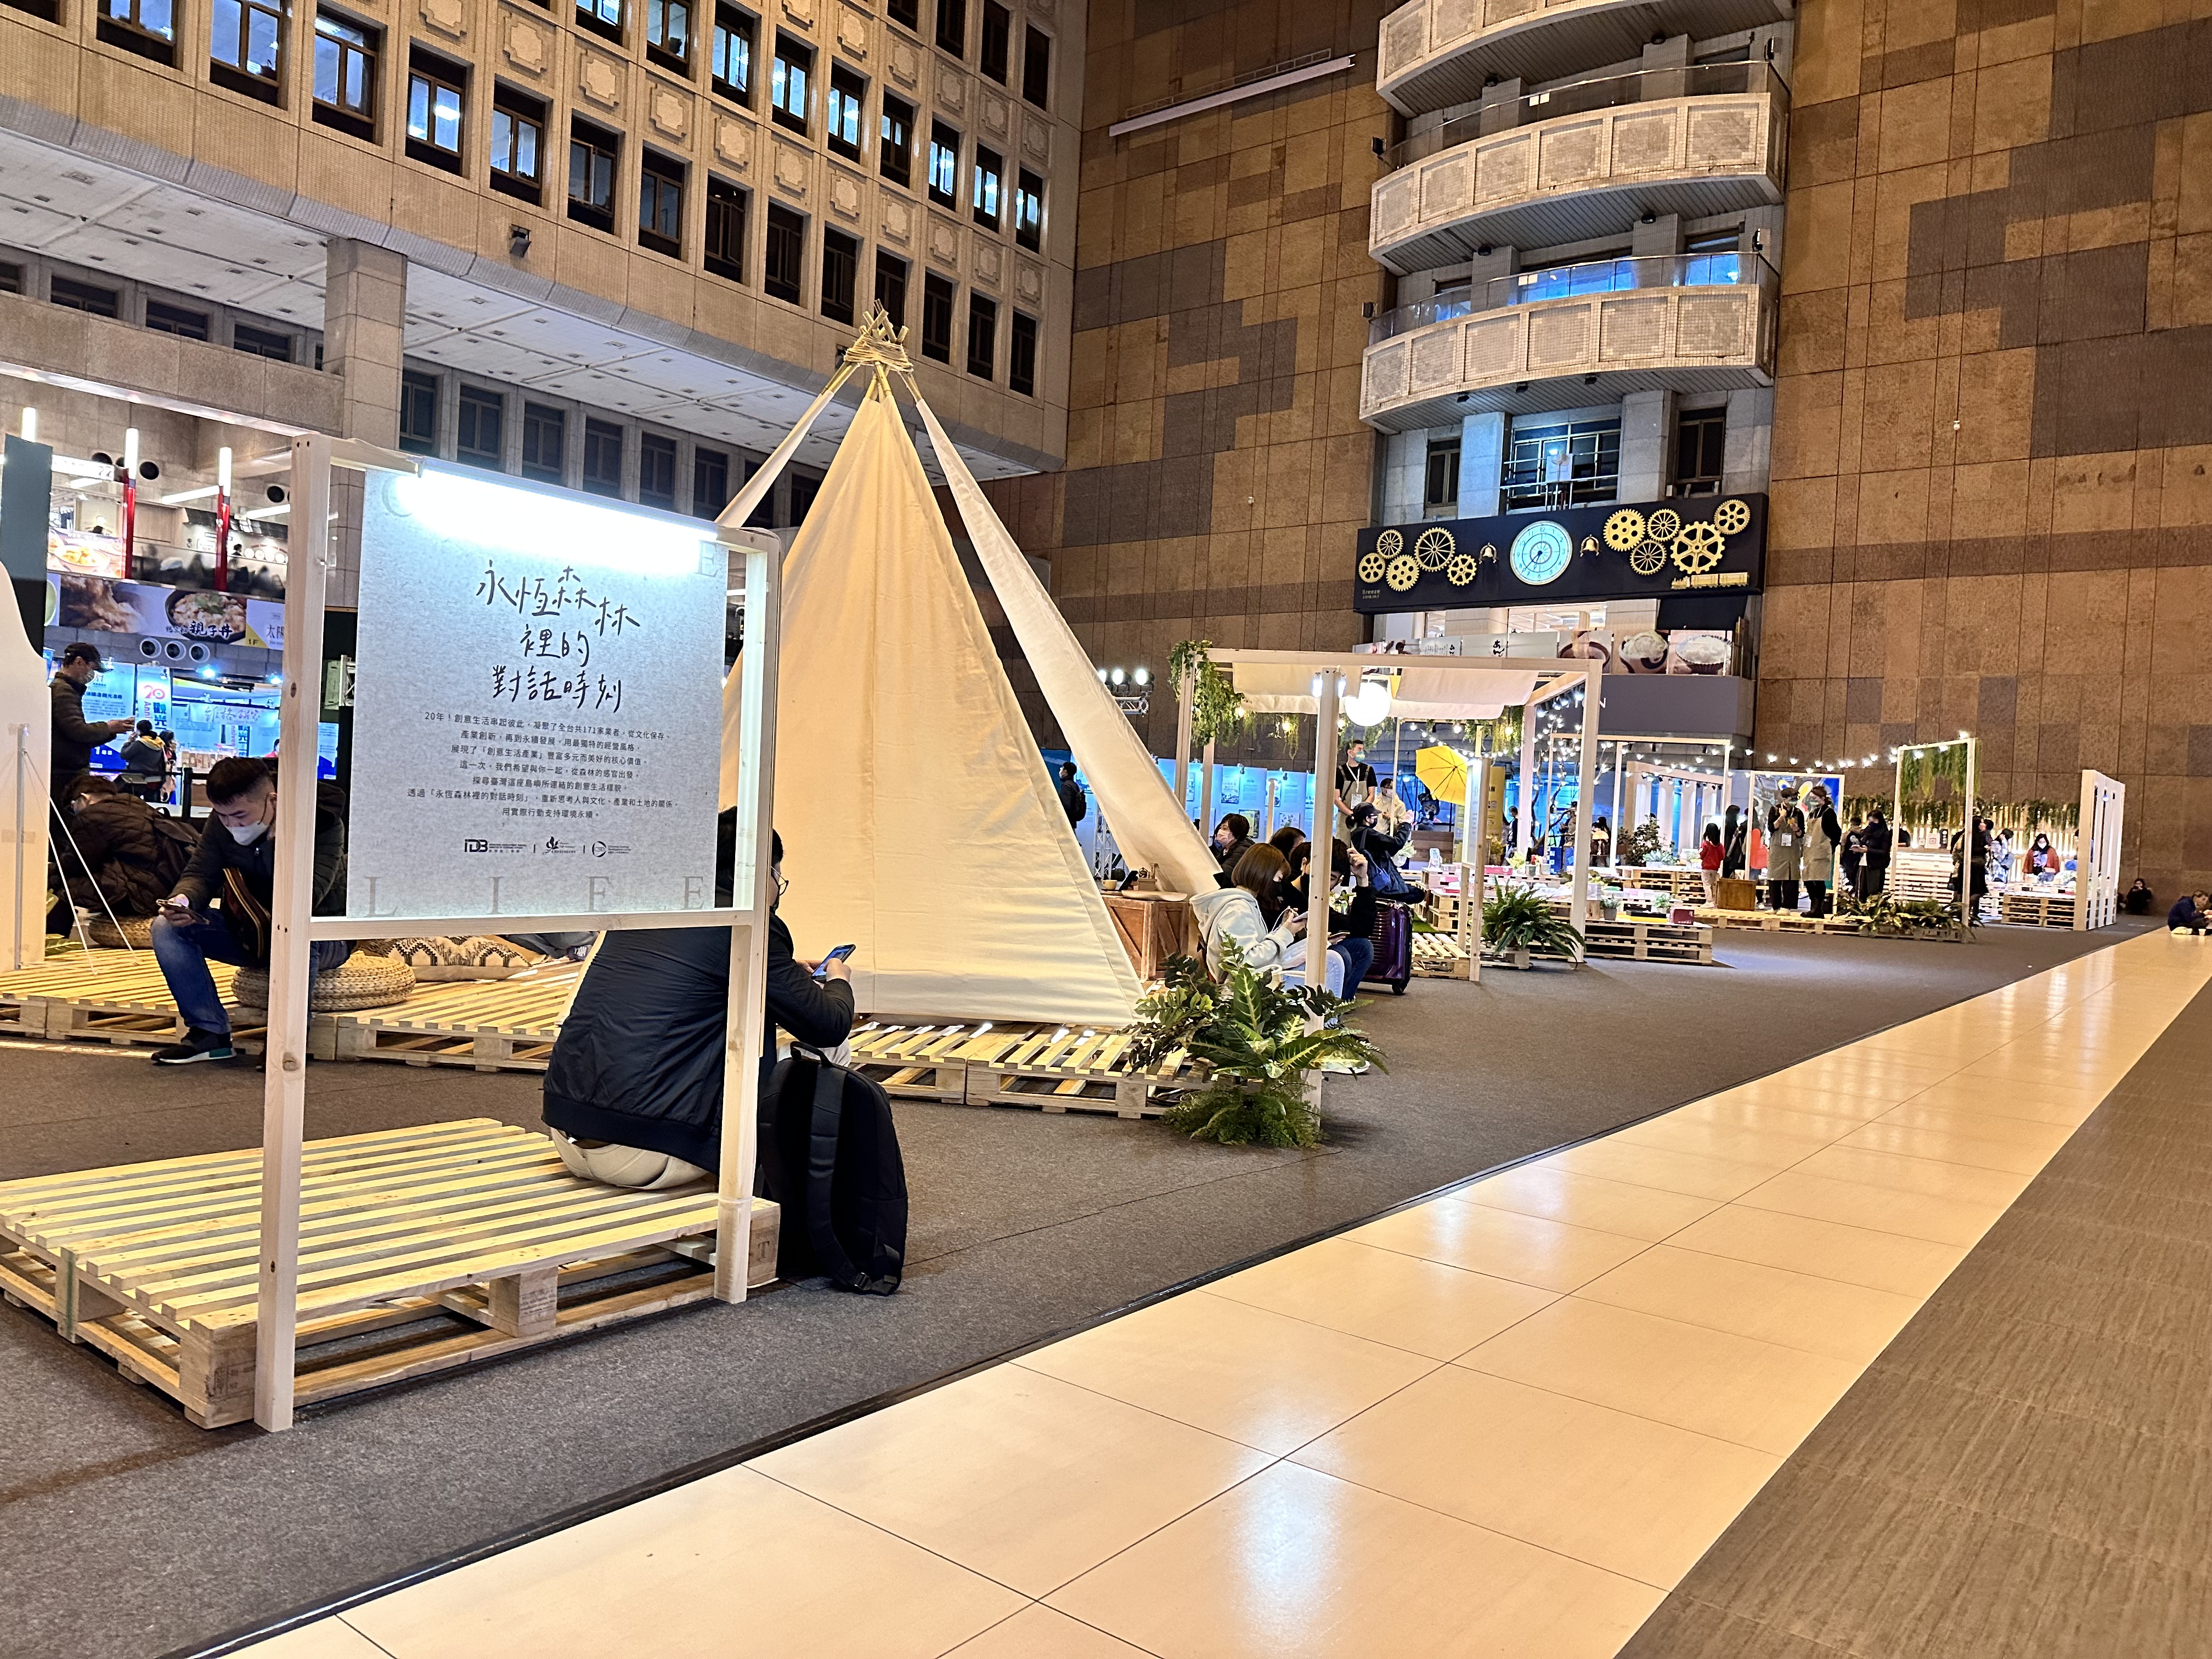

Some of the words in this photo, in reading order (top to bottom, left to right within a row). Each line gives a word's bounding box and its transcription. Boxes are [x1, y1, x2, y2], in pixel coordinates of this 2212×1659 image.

[521, 623, 589, 668] 裡的
[493, 665, 621, 713] 對話時刻
